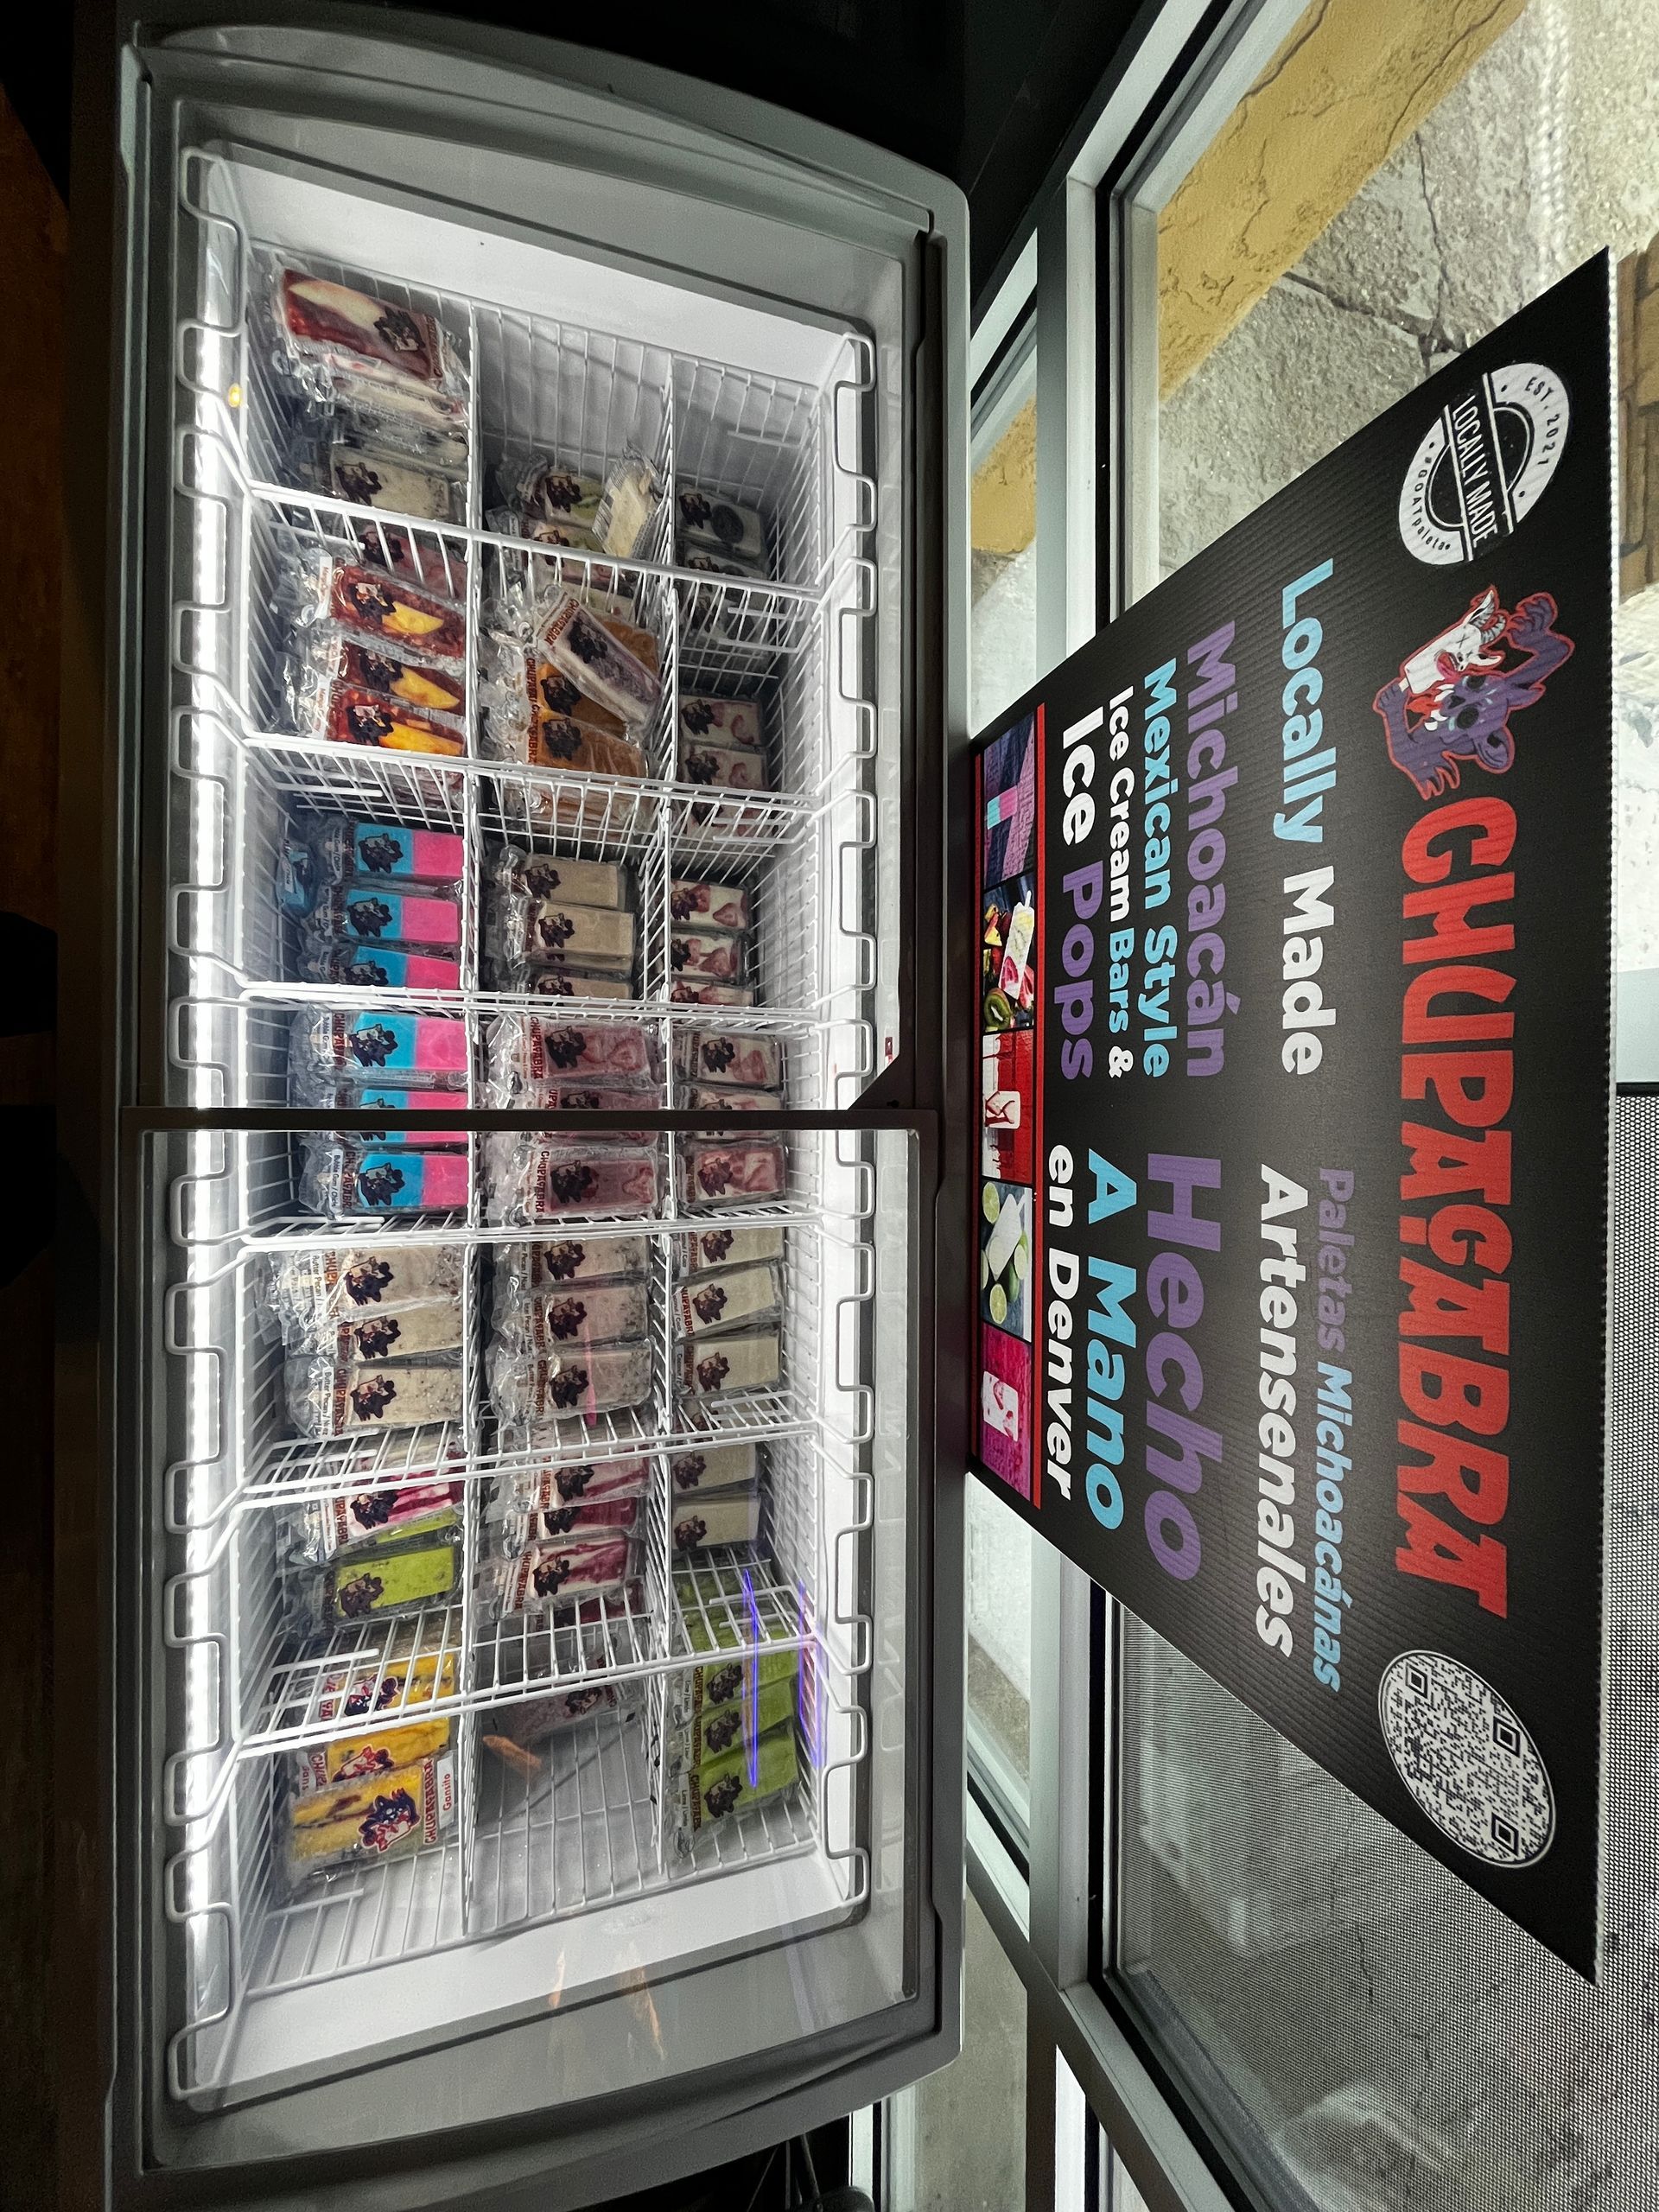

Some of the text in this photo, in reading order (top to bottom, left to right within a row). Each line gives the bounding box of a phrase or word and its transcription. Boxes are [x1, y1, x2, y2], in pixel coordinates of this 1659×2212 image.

[1452, 395, 1497, 549] LOCALLY MADE
[1537, 413, 1560, 466] 2021
[1054, 708, 1103, 1079] Ice Pops
[1108, 687, 1135, 1078] Ice Cream Bars &
[1138, 658, 1177, 1077] Mexican Style
[1186, 622, 1240, 1077] Michoacán
[1274, 559, 1335, 1075] Locally Made
[331, 1173, 340, 1186] Gum
[1046, 1145, 1078, 1501] en Denver
[1084, 1149, 1136, 1530] A Mano
[1144, 1154, 1223, 1580] Hecho
[1255, 1165, 1308, 1657] Artensenales
[1312, 1168, 1353, 1692] Paletas Michoacánas
[442, 1774, 451, 1812] Gansito
